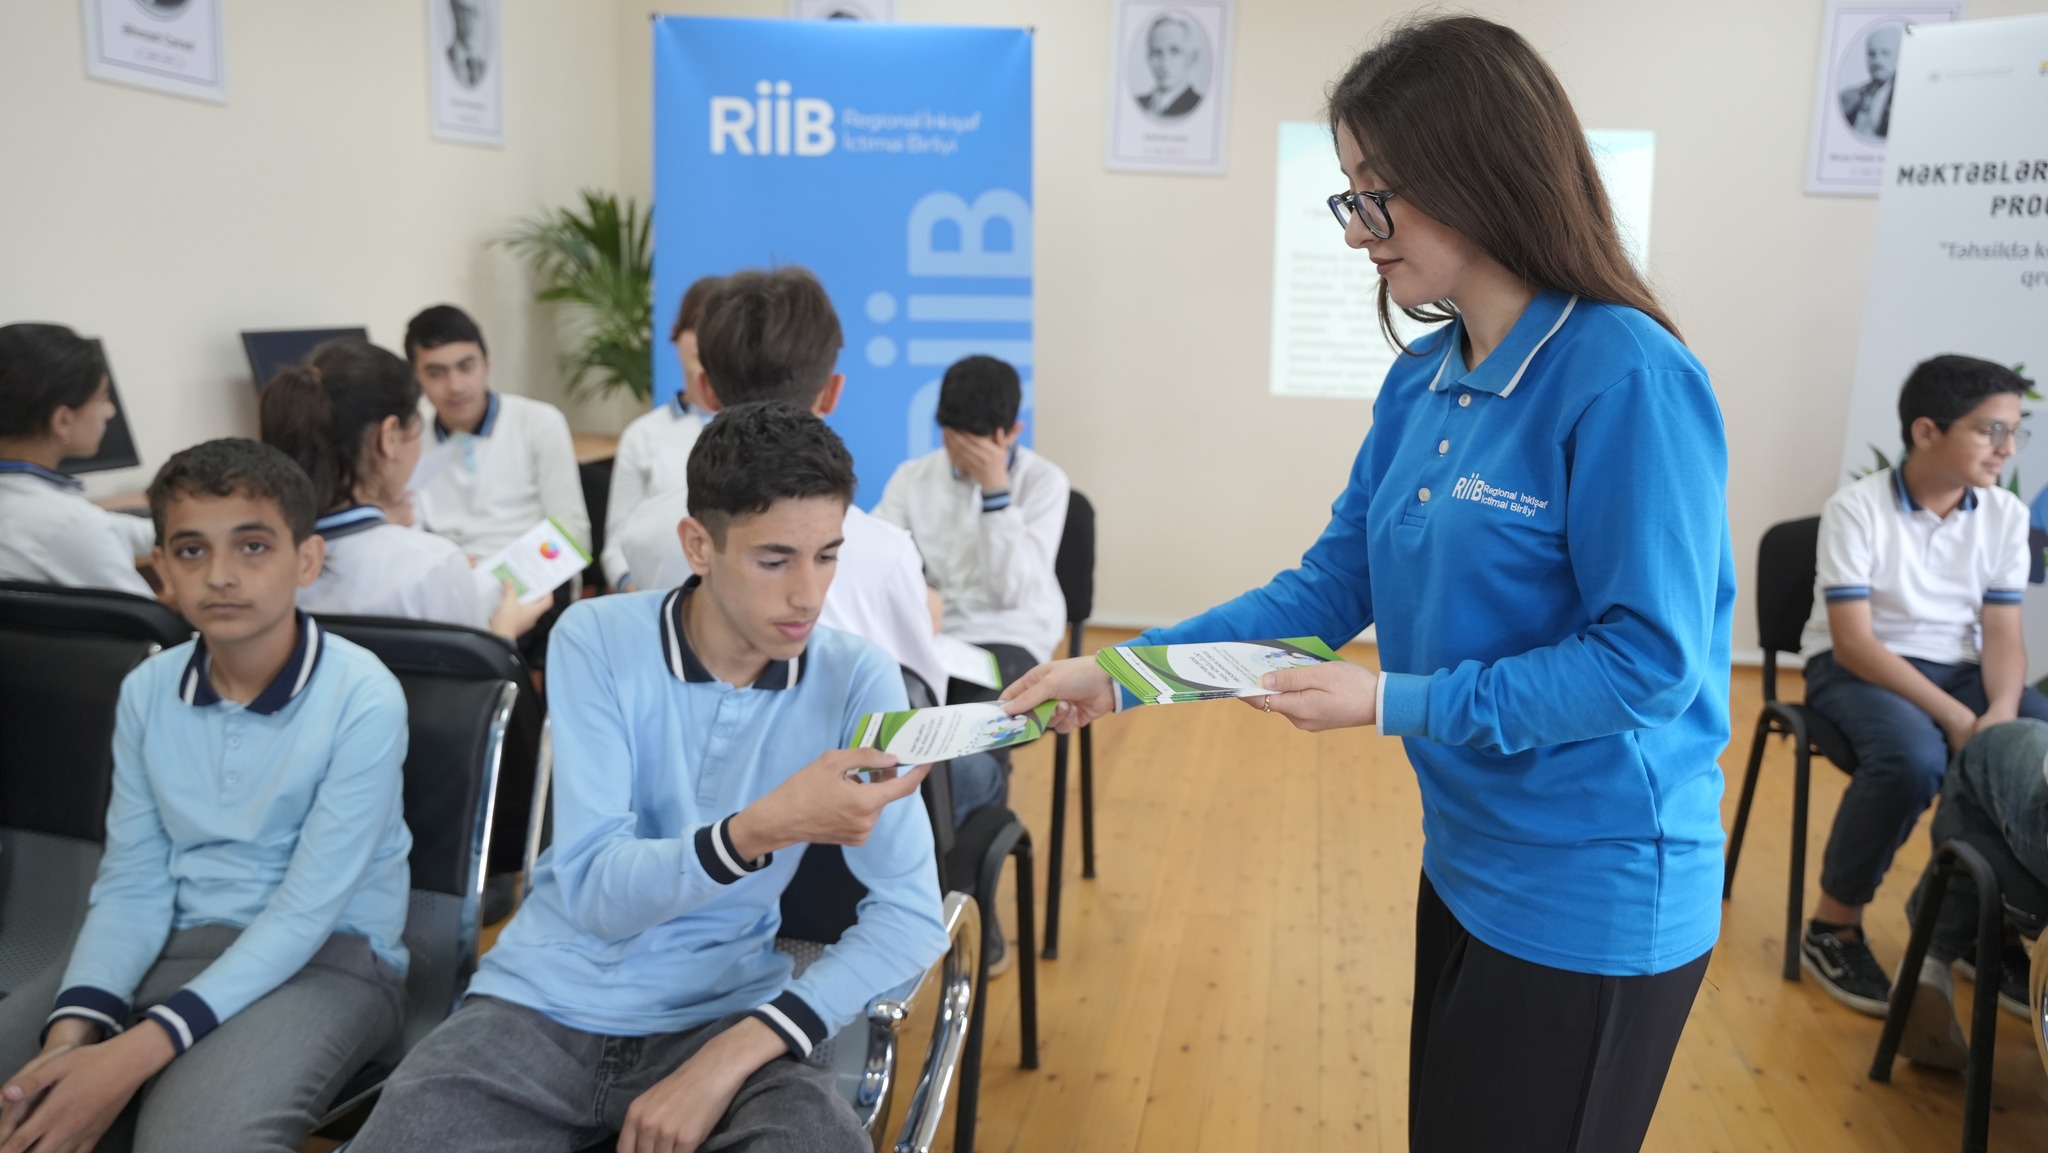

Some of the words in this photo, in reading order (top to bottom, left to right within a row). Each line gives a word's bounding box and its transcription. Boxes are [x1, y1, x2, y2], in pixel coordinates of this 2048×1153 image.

[842, 108, 920, 132] Regional
[1483, 485, 1517, 500] Regional
[1510, 502, 1537, 517] Birliyi
